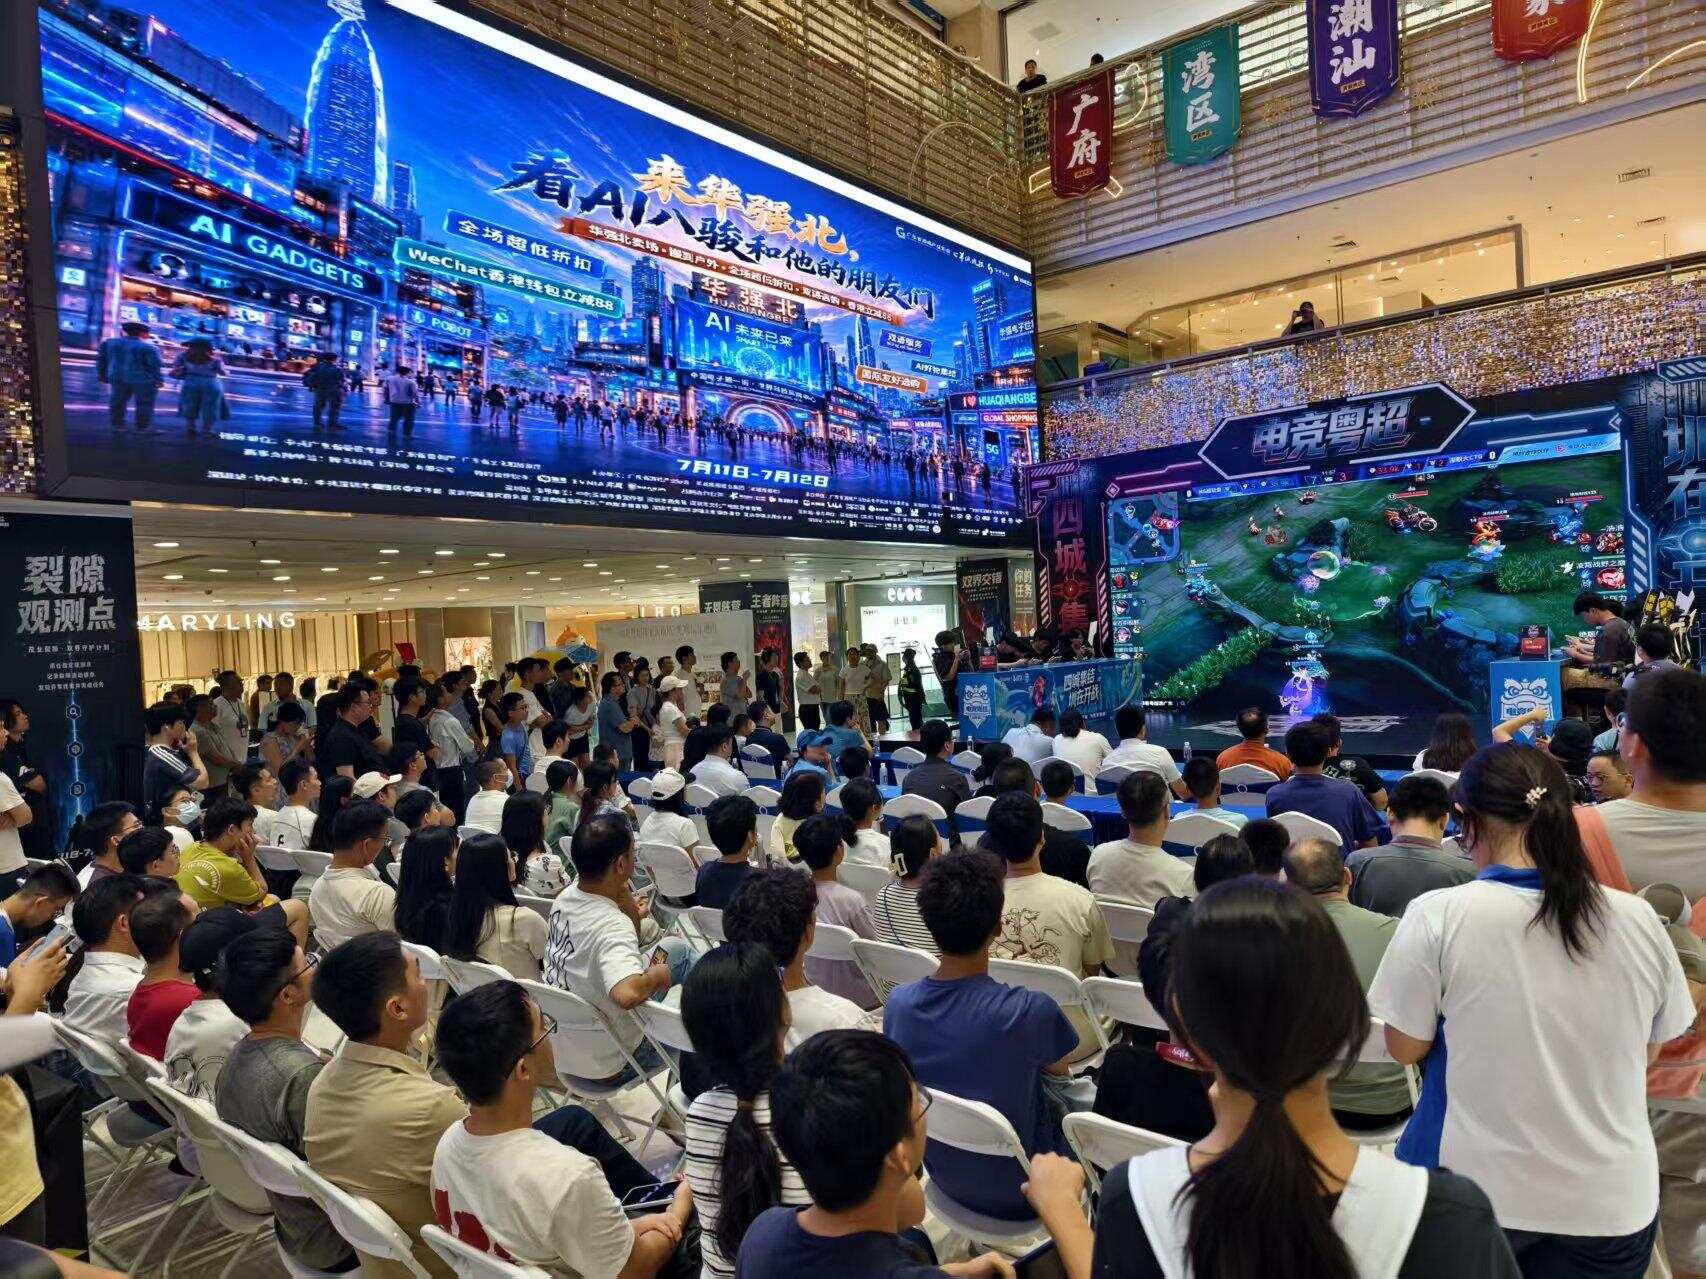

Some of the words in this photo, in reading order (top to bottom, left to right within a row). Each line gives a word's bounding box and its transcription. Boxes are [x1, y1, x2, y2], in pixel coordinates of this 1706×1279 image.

[1328, 0, 1376, 85] 潮汕
[1182, 50, 1220, 132] 湾区
[1066, 94, 1102, 169] 广府
[190, 215, 232, 244] AI
[247, 234, 365, 289] GADGETS
[458, 219, 592, 273] 全场超低折扣
[408, 246, 615, 311] WeChat香港钱包立减88
[700, 275, 798, 319] 华强北
[705, 311, 730, 333] AI
[735, 323, 793, 347] 未来已来
[983, 413, 1004, 422] GLOBAL
[1005, 411, 1038, 422] SHOPPING
[1252, 397, 1414, 465] 电竞粤超
[985, 443, 999, 455] 5G
[677, 459, 829, 488] 7月11日-7月12日
[21, 553, 106, 595] 裂隙
[16, 595, 117, 634] 观测点
[751, 594, 789, 609] 王者阵营
